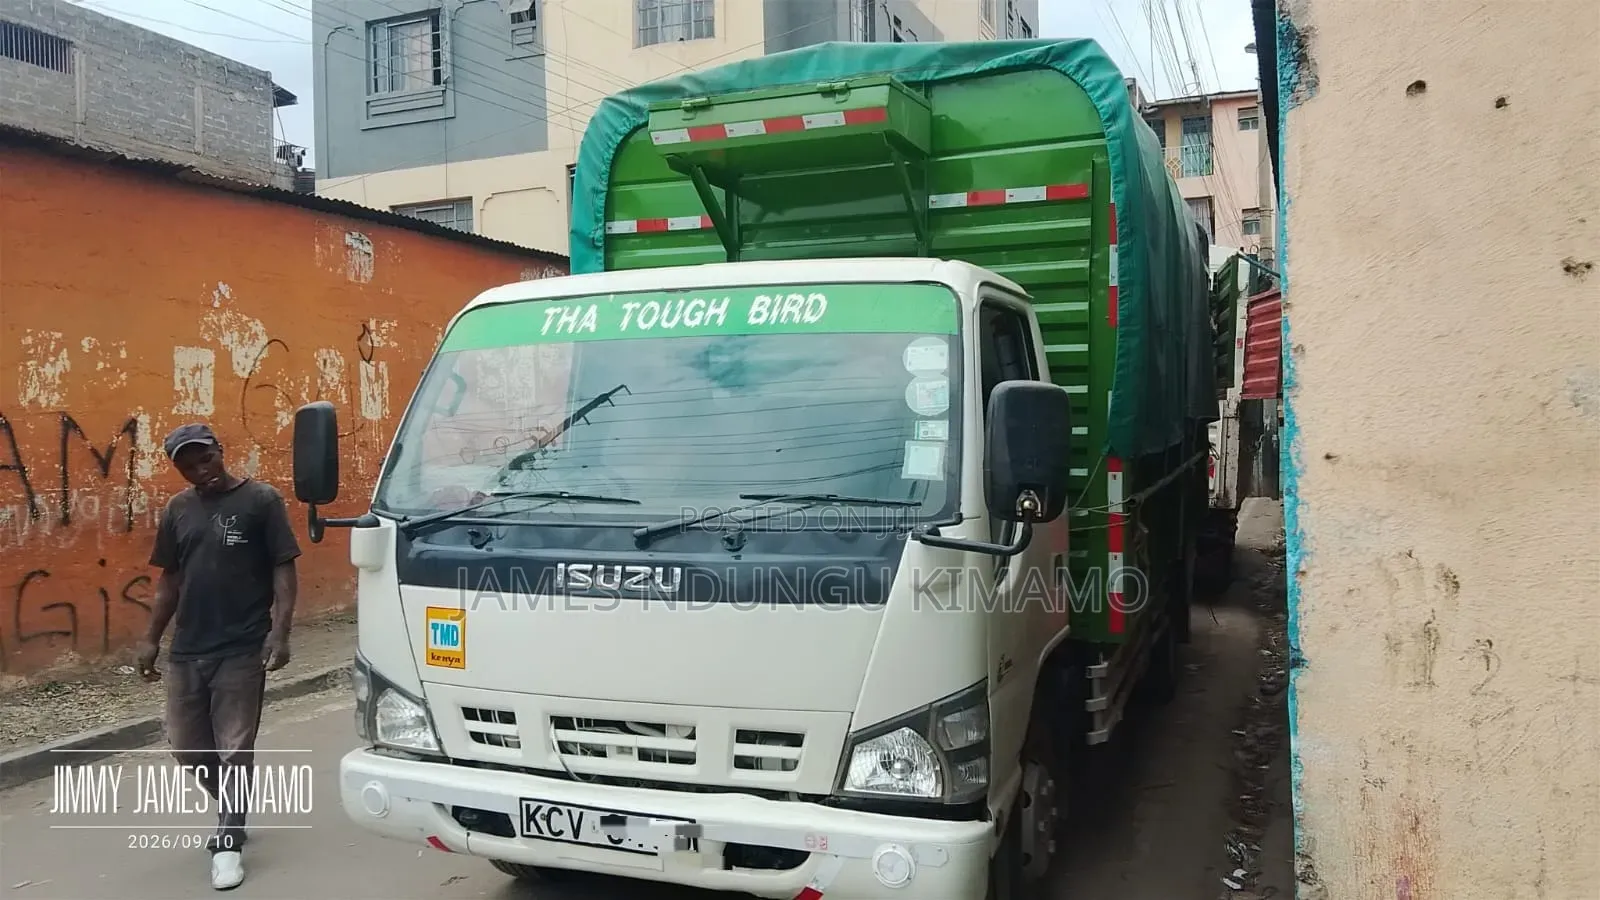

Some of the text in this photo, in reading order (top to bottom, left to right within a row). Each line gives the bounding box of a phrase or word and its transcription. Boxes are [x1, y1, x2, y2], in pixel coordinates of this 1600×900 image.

[541, 292, 828, 336] THA TOUGH BIRD
[556, 562, 682, 593] ISUZU
[431, 622, 459, 647] TMD
[431, 652, 461, 665] kenya
[524, 803, 584, 840] KCV
